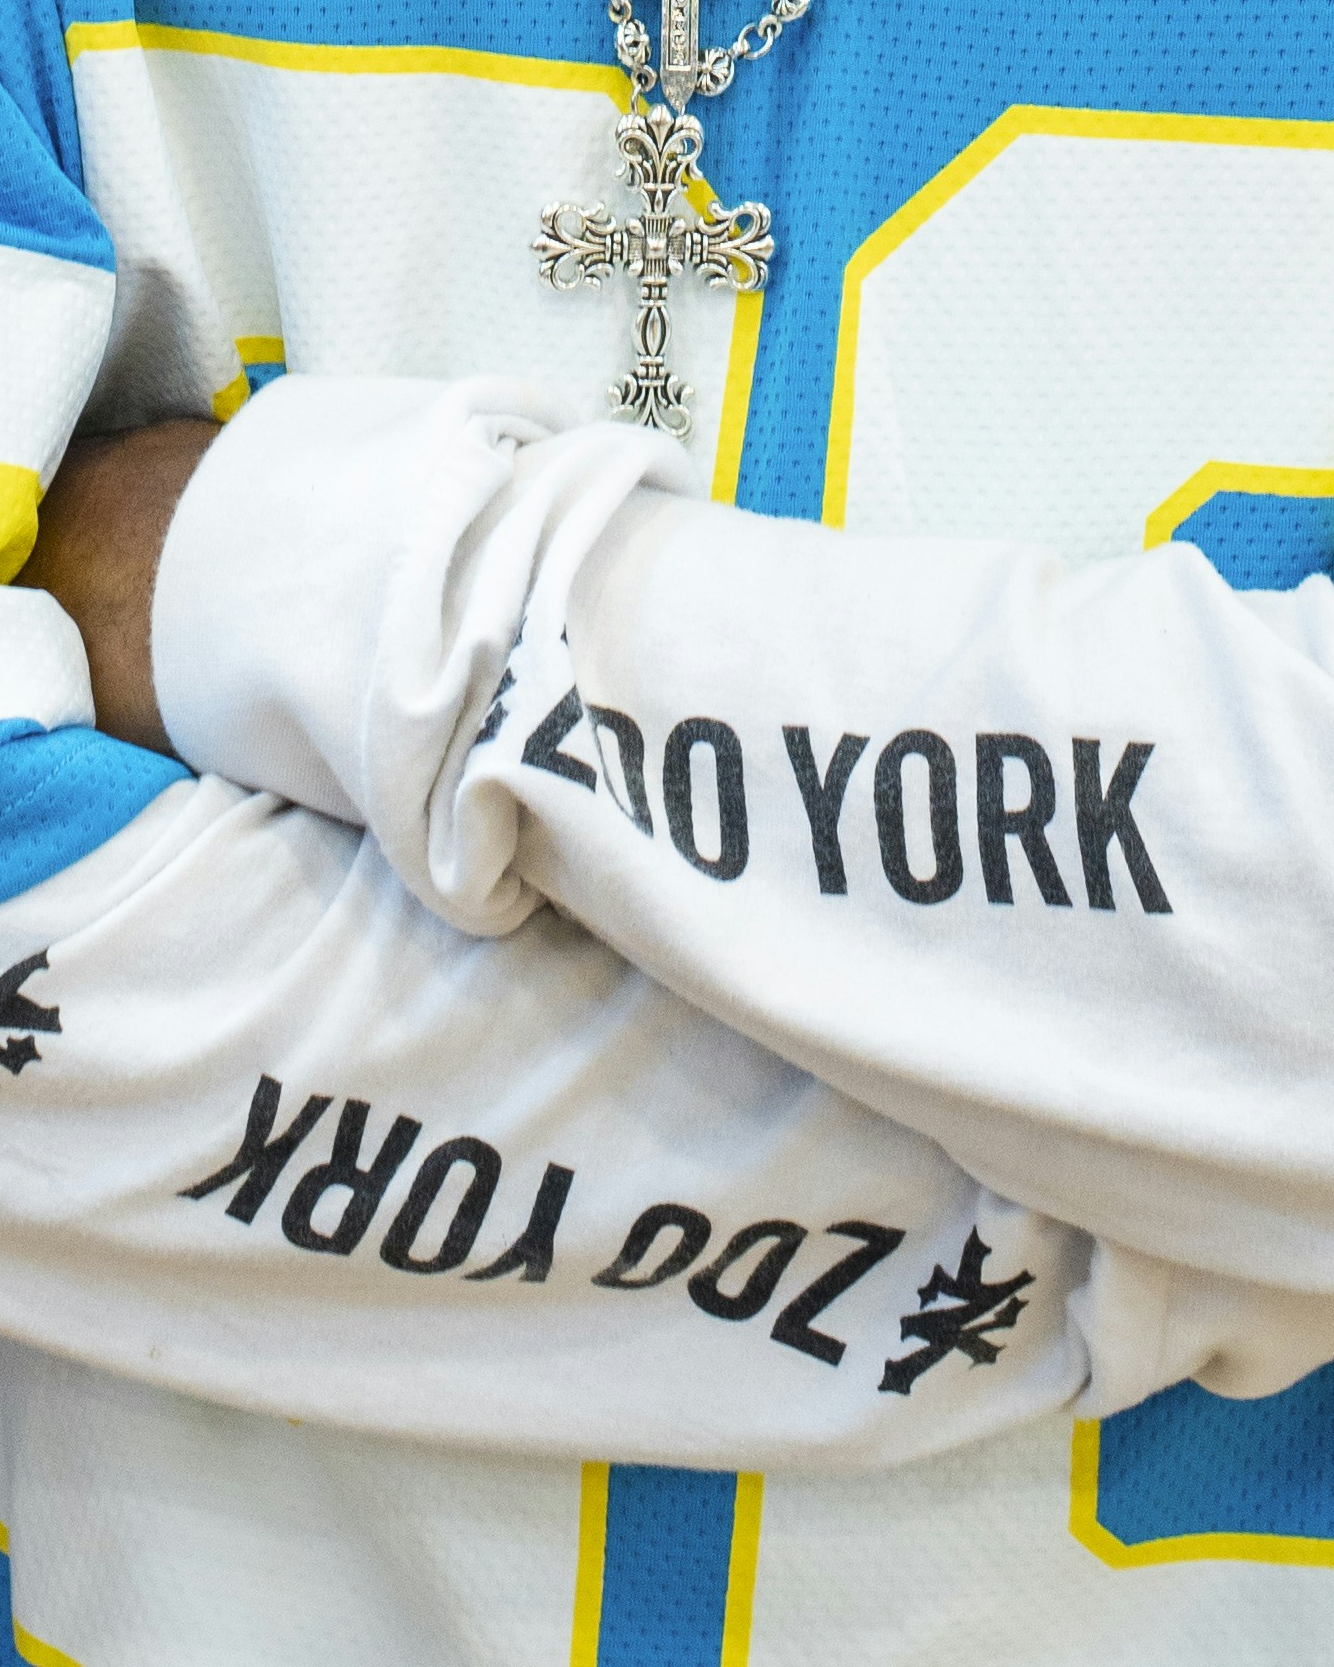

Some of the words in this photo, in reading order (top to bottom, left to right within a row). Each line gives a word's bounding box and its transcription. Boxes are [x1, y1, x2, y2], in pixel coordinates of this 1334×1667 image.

[781, 724, 1175, 916] YORK
[174, 1072, 576, 1284] YORK
[590, 1202, 907, 1368] ZOO
